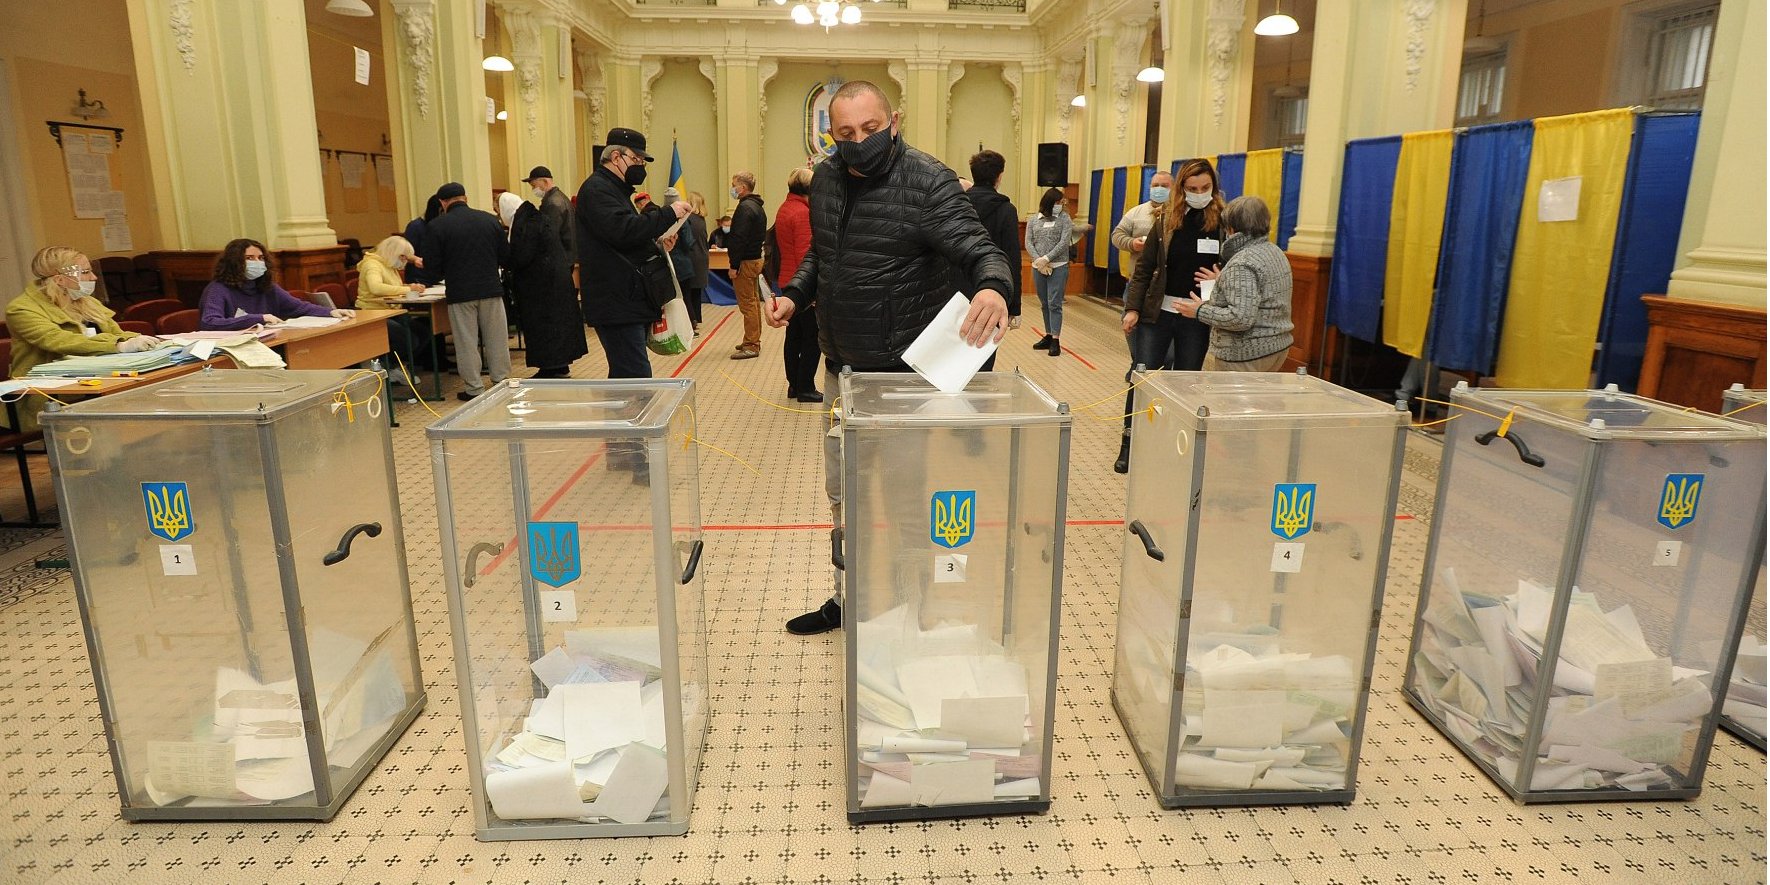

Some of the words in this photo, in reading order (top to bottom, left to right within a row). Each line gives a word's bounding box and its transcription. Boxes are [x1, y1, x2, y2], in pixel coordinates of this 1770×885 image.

[1283, 551, 1290, 560] 4
[1665, 549, 1671, 557] 5
[174, 555, 182, 564] 1
[947, 562, 954, 572] 3
[554, 601, 562, 611] 2
